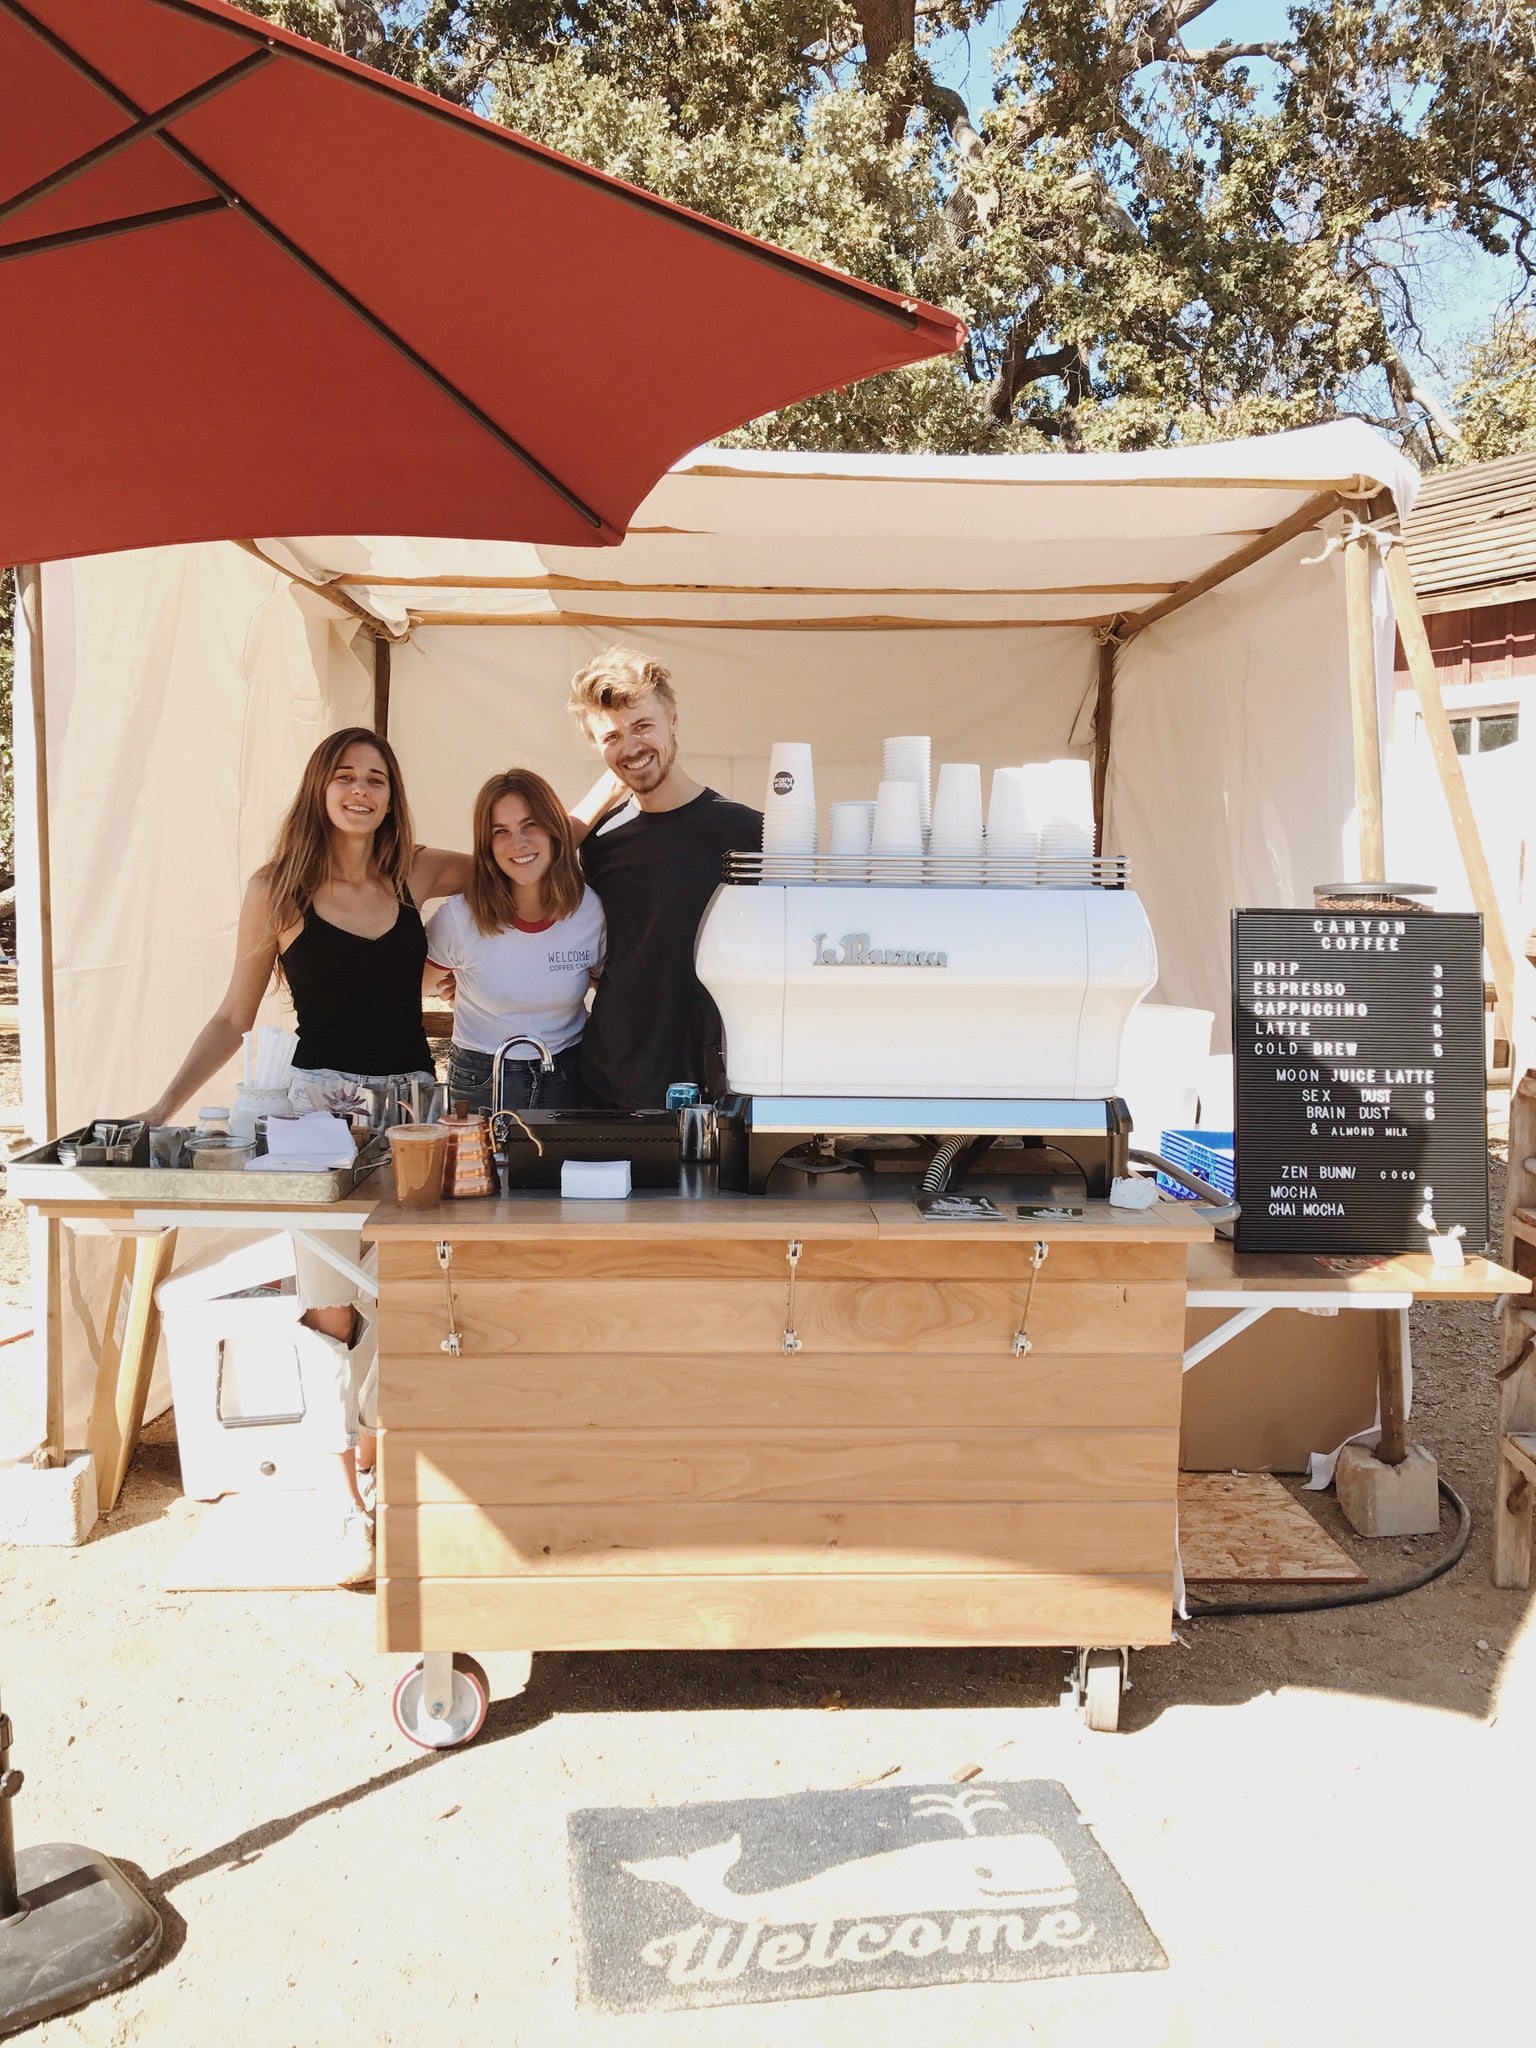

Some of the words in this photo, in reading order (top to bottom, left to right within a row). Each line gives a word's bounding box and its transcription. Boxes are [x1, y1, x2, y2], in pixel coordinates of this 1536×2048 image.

[1313, 920, 1406, 935] CANYON
[1321, 937, 1400, 951] COFFEE
[548, 950, 590, 963] WELCOME
[549, 964, 575, 972] COFFEE
[1253, 961, 1300, 976] DRIP
[1433, 964, 1443, 978] 3
[1253, 982, 1346, 996] ESPRESSO
[1433, 984, 1444, 998] 3
[1253, 1001, 1368, 1017] CAPPUCCINO
[1433, 1004, 1443, 1018] 4
[1255, 1021, 1311, 1036] LATTE
[1433, 1023, 1443, 1038] 5
[1254, 1042, 1298, 1056] COLD
[1312, 1042, 1358, 1057] BREW
[1433, 1043, 1443, 1058] 5
[1276, 1069, 1319, 1082] MOON
[1331, 1069, 1376, 1083] JUICE
[1385, 1070, 1435, 1084] LATTE
[1302, 1089, 1331, 1102] SEX
[1360, 1088, 1392, 1103] DUST
[1425, 1090, 1435, 1104] 6
[1306, 1106, 1346, 1119] BRAIN
[1359, 1106, 1391, 1120] DUST
[1425, 1106, 1435, 1121] 6
[1309, 1122, 1319, 1136] &
[1331, 1126, 1375, 1137] ALMOND
[1385, 1127, 1408, 1137] MILK
[1281, 1165, 1308, 1179] ZEN
[1380, 1170, 1416, 1181] COCO
[1270, 1186, 1318, 1199] MOCHA
[1423, 1186, 1434, 1201] 6
[1268, 1203, 1296, 1216] CHAI
[1303, 1203, 1345, 1216] MOCHA
[640, 1909, 1096, 1985] Welcome
